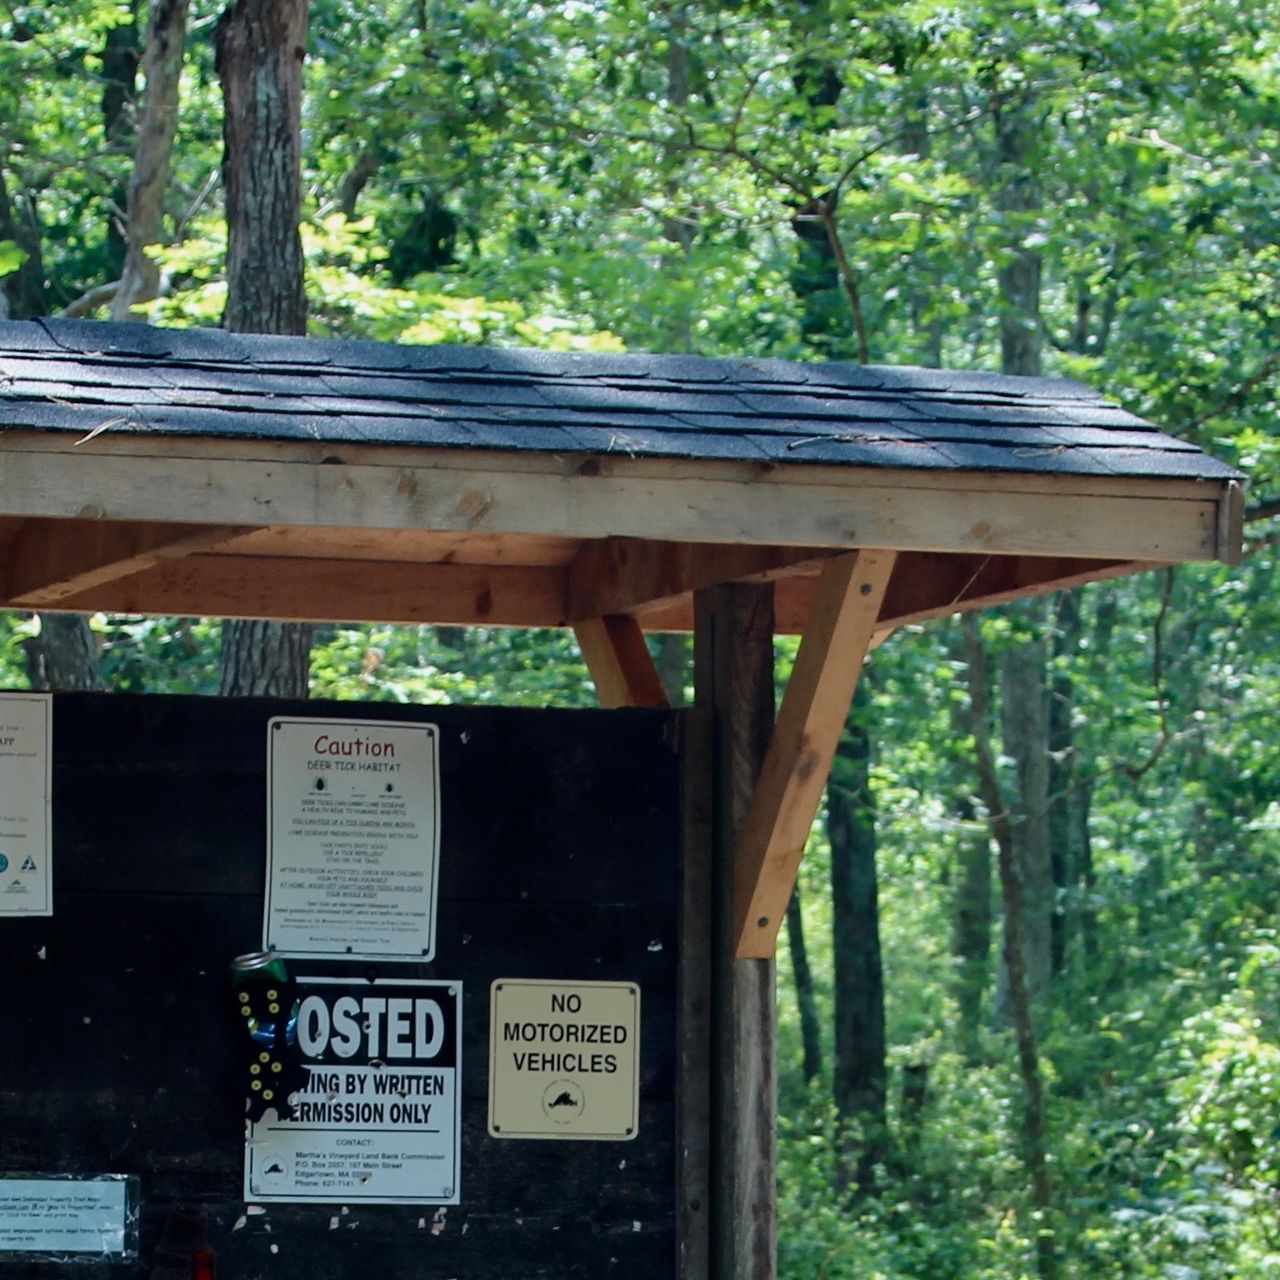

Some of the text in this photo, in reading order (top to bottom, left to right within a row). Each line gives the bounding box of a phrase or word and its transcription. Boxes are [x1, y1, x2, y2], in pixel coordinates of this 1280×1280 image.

[314, 735, 395, 757] Caution
[307, 761, 401, 773] DEER TICK HABITAT
[551, 994, 582, 1013] NO
[297, 995, 445, 1059] OSTED
[504, 1023, 628, 1044] MOTORIZED
[513, 1052, 618, 1073] VEHICLES
[346, 1074, 367, 1094] BY
[373, 1075, 444, 1095] WRITTEN
[278, 1102, 432, 1124] ERMISSION ONLY
[296, 1151, 327, 1159] Martha's
[328, 1152, 360, 1160] Vineyard
[381, 1152, 399, 1160] Bank
